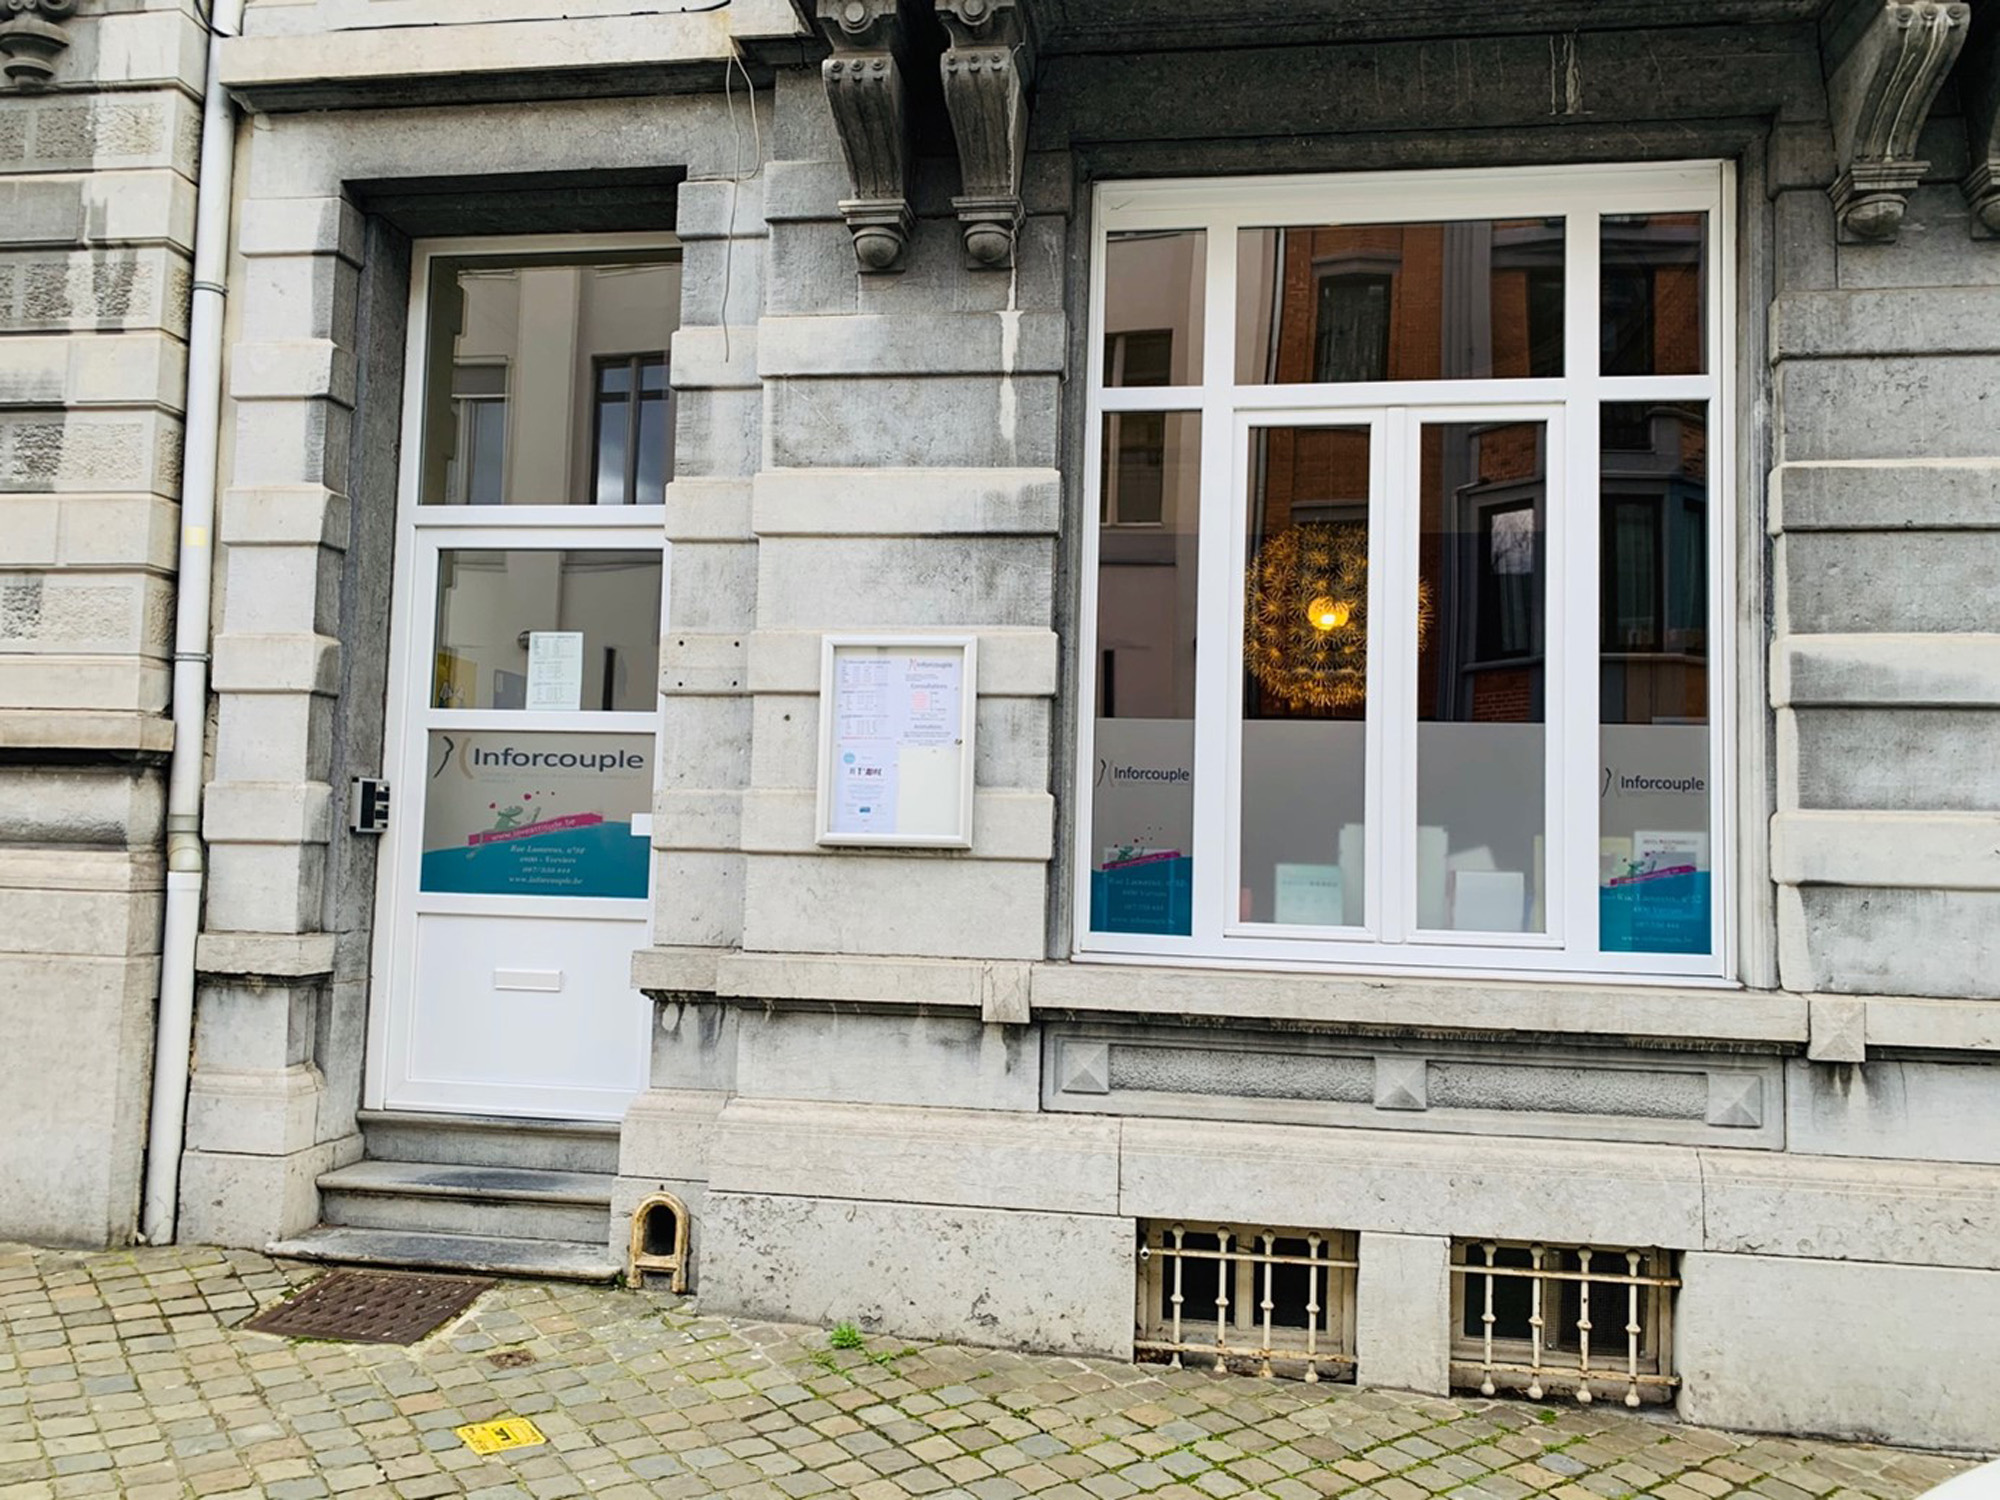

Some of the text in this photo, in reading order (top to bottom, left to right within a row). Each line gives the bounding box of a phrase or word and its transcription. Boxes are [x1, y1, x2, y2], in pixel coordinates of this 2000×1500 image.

[474, 748, 644, 772] Inforcouple
[1114, 766, 1190, 783] Inforcouple
[1621, 775, 1705, 792] Inforcouple
